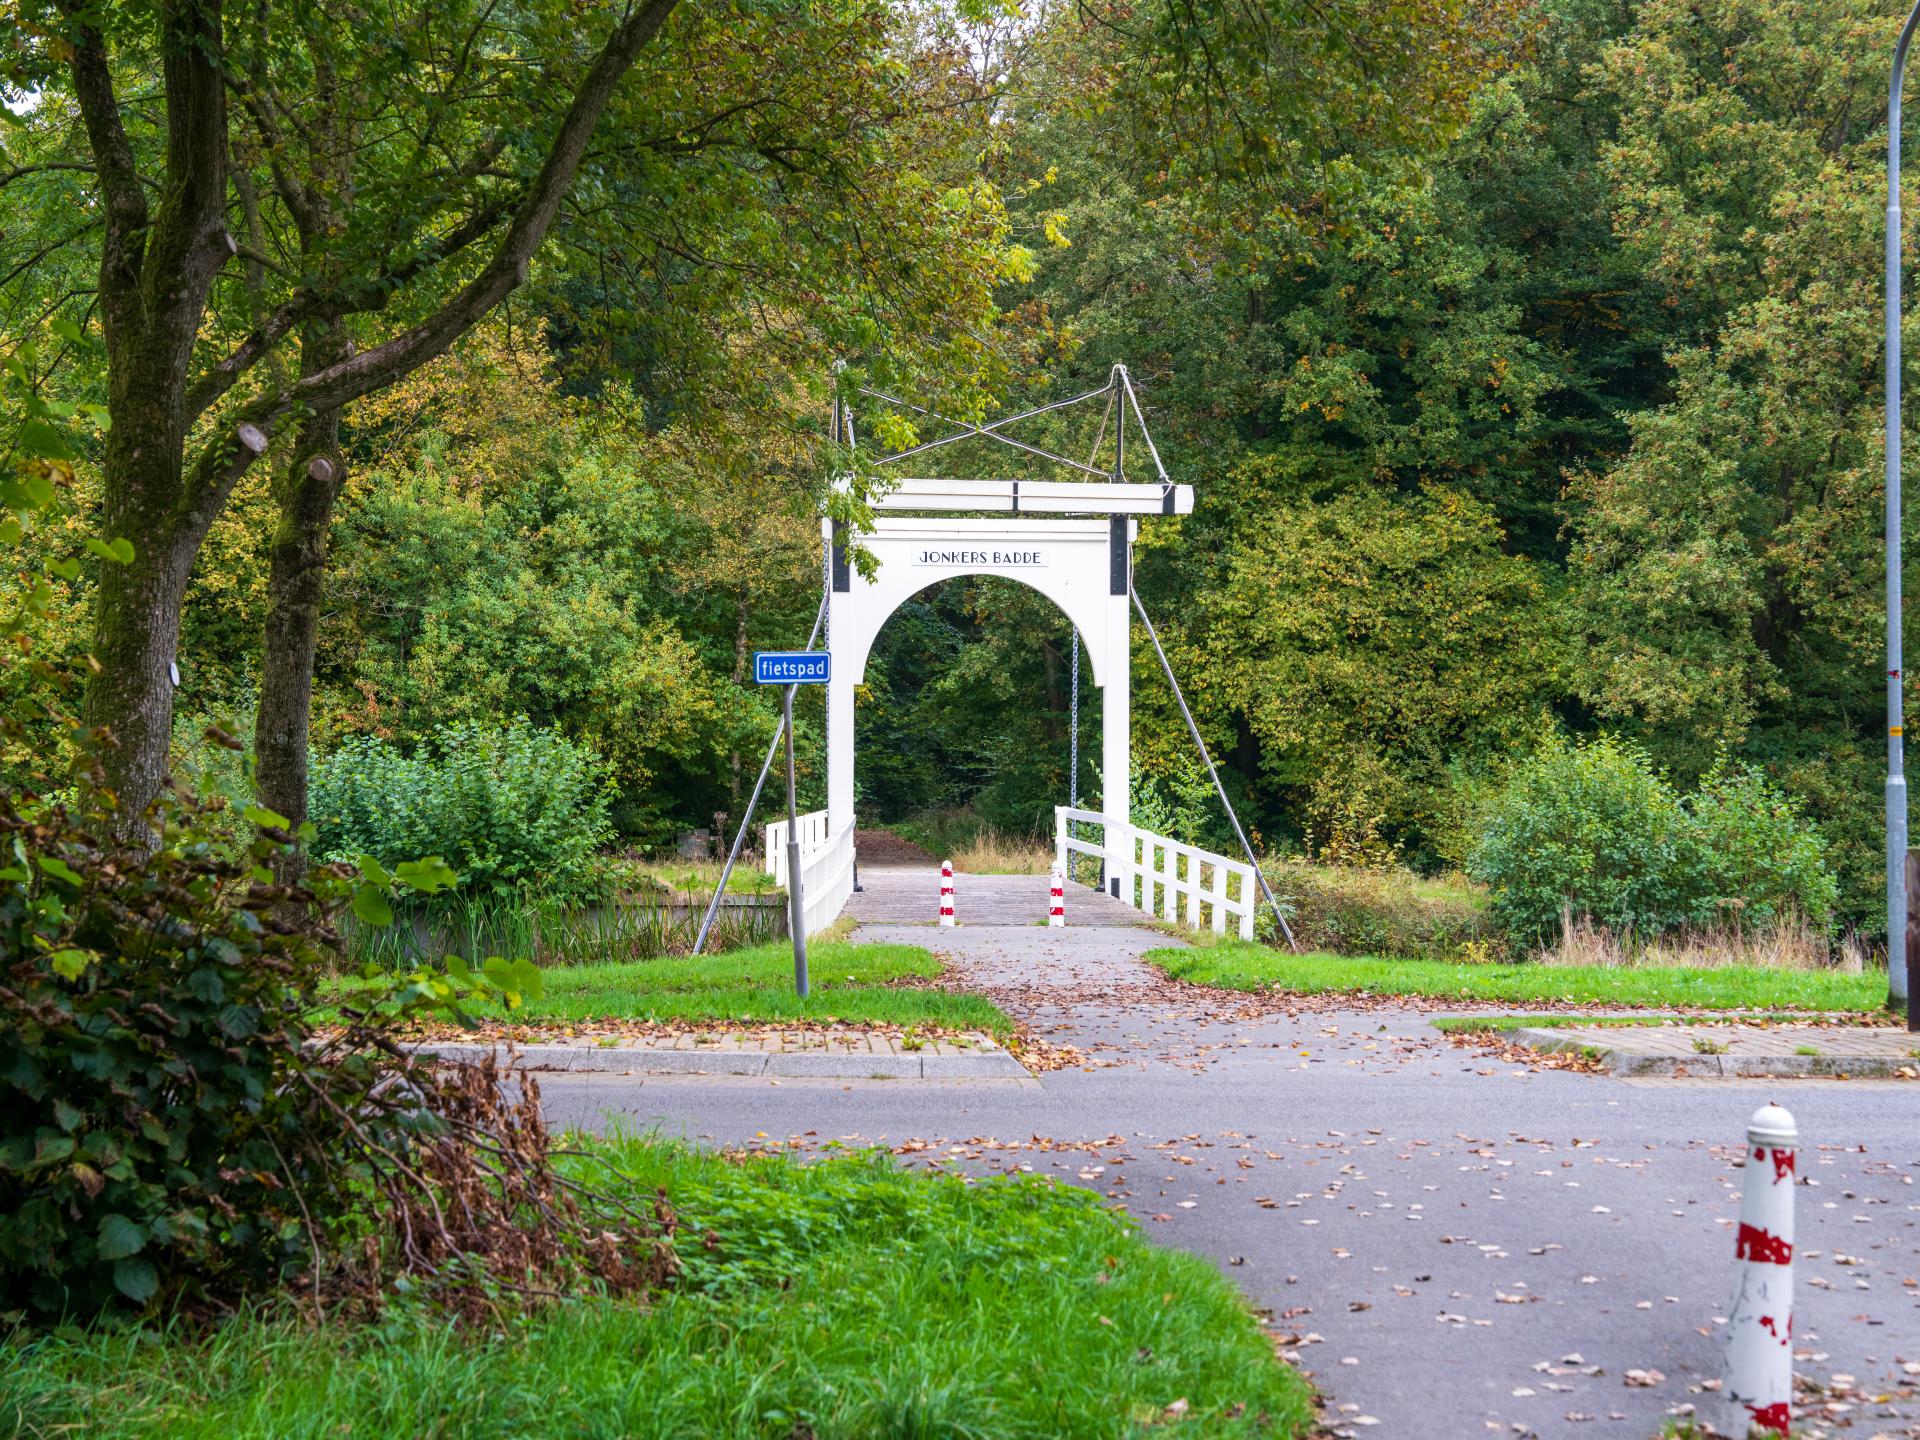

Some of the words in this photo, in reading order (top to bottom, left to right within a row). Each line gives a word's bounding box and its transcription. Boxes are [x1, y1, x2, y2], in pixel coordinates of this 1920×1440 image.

[919, 551, 987, 564] JONKERS
[993, 551, 1041, 564] BADDE
[762, 660, 825, 678] fietspad
